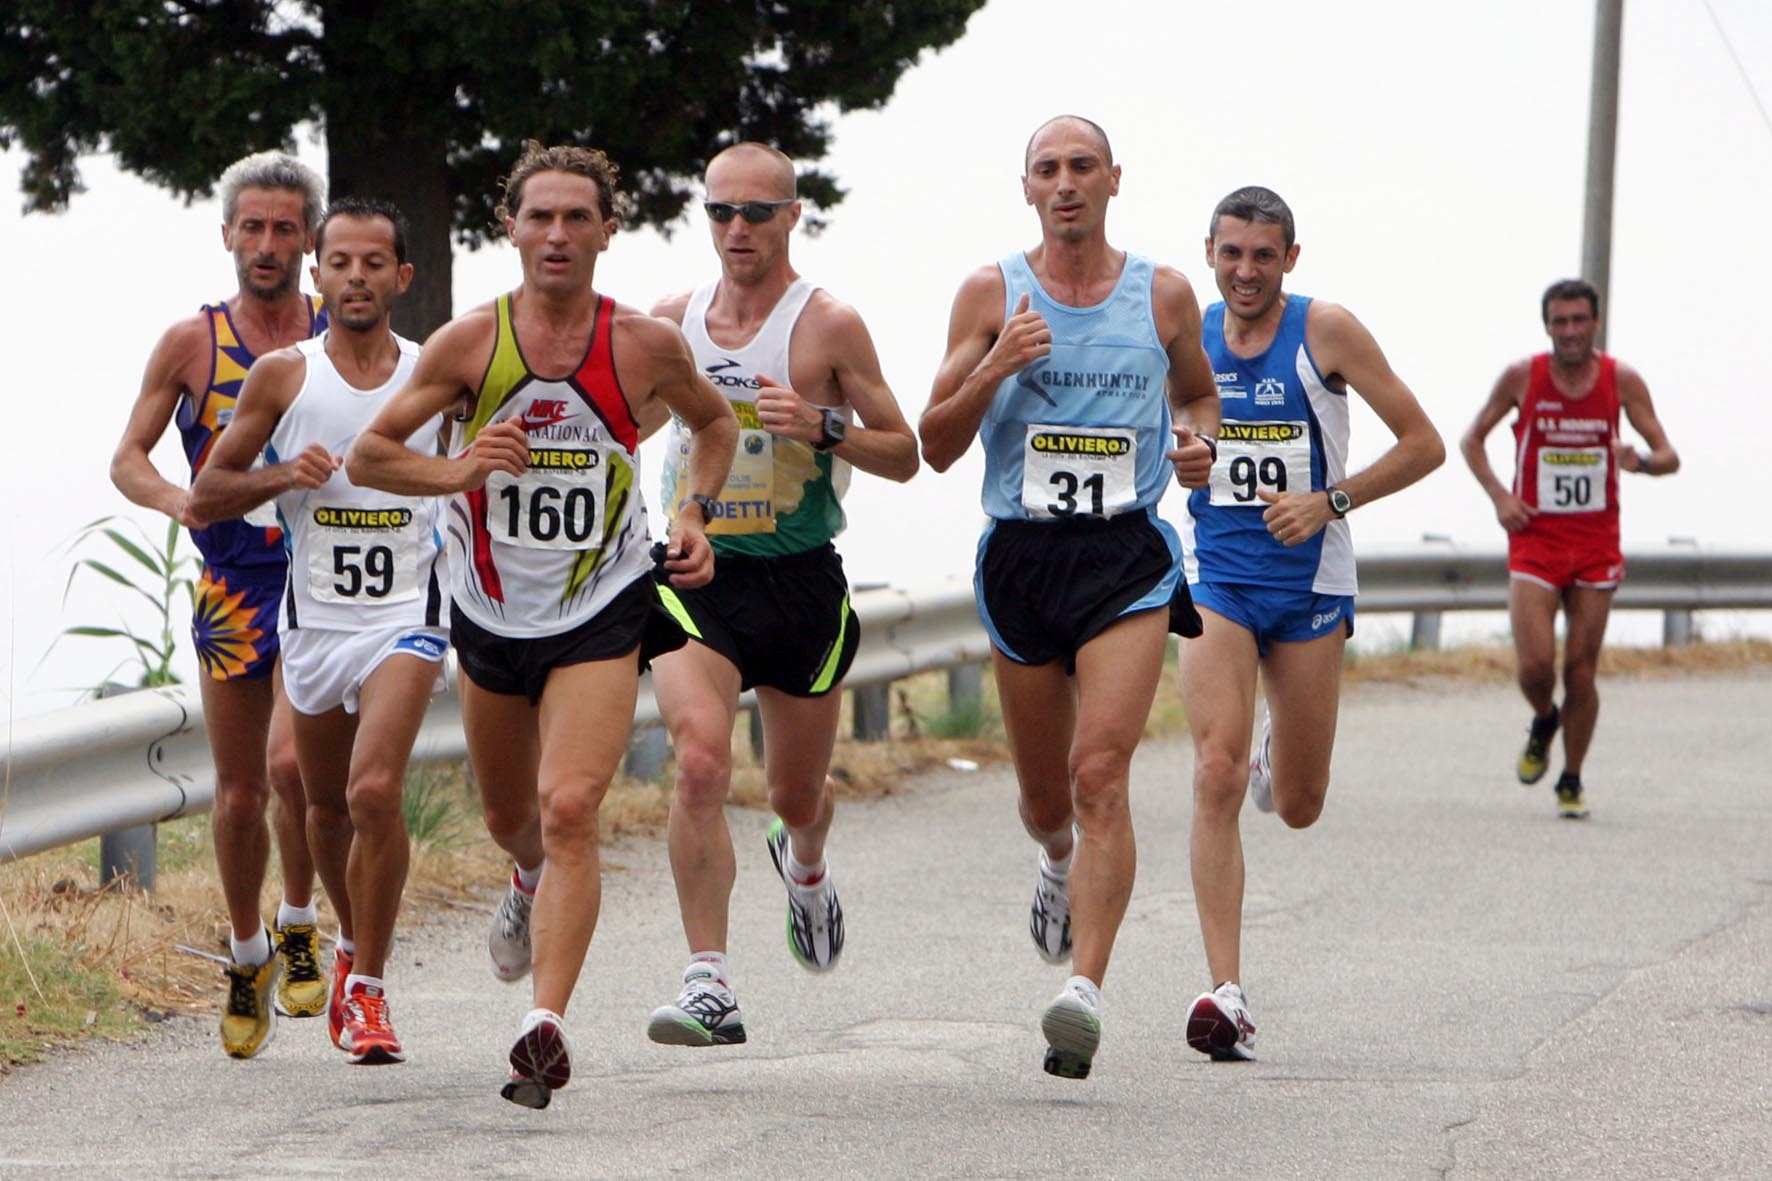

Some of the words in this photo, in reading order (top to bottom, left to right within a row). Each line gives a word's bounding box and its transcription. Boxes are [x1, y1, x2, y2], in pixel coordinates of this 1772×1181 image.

[704, 374, 763, 389] OOKS
[1041, 370, 1149, 391] GLENHUNTLY
[527, 399, 569, 418] NIKE
[1047, 471, 1103, 517] 31
[1230, 456, 1287, 502] 99
[1554, 475, 1591, 507] 50
[500, 485, 595, 542] 160
[333, 545, 394, 597] 59
